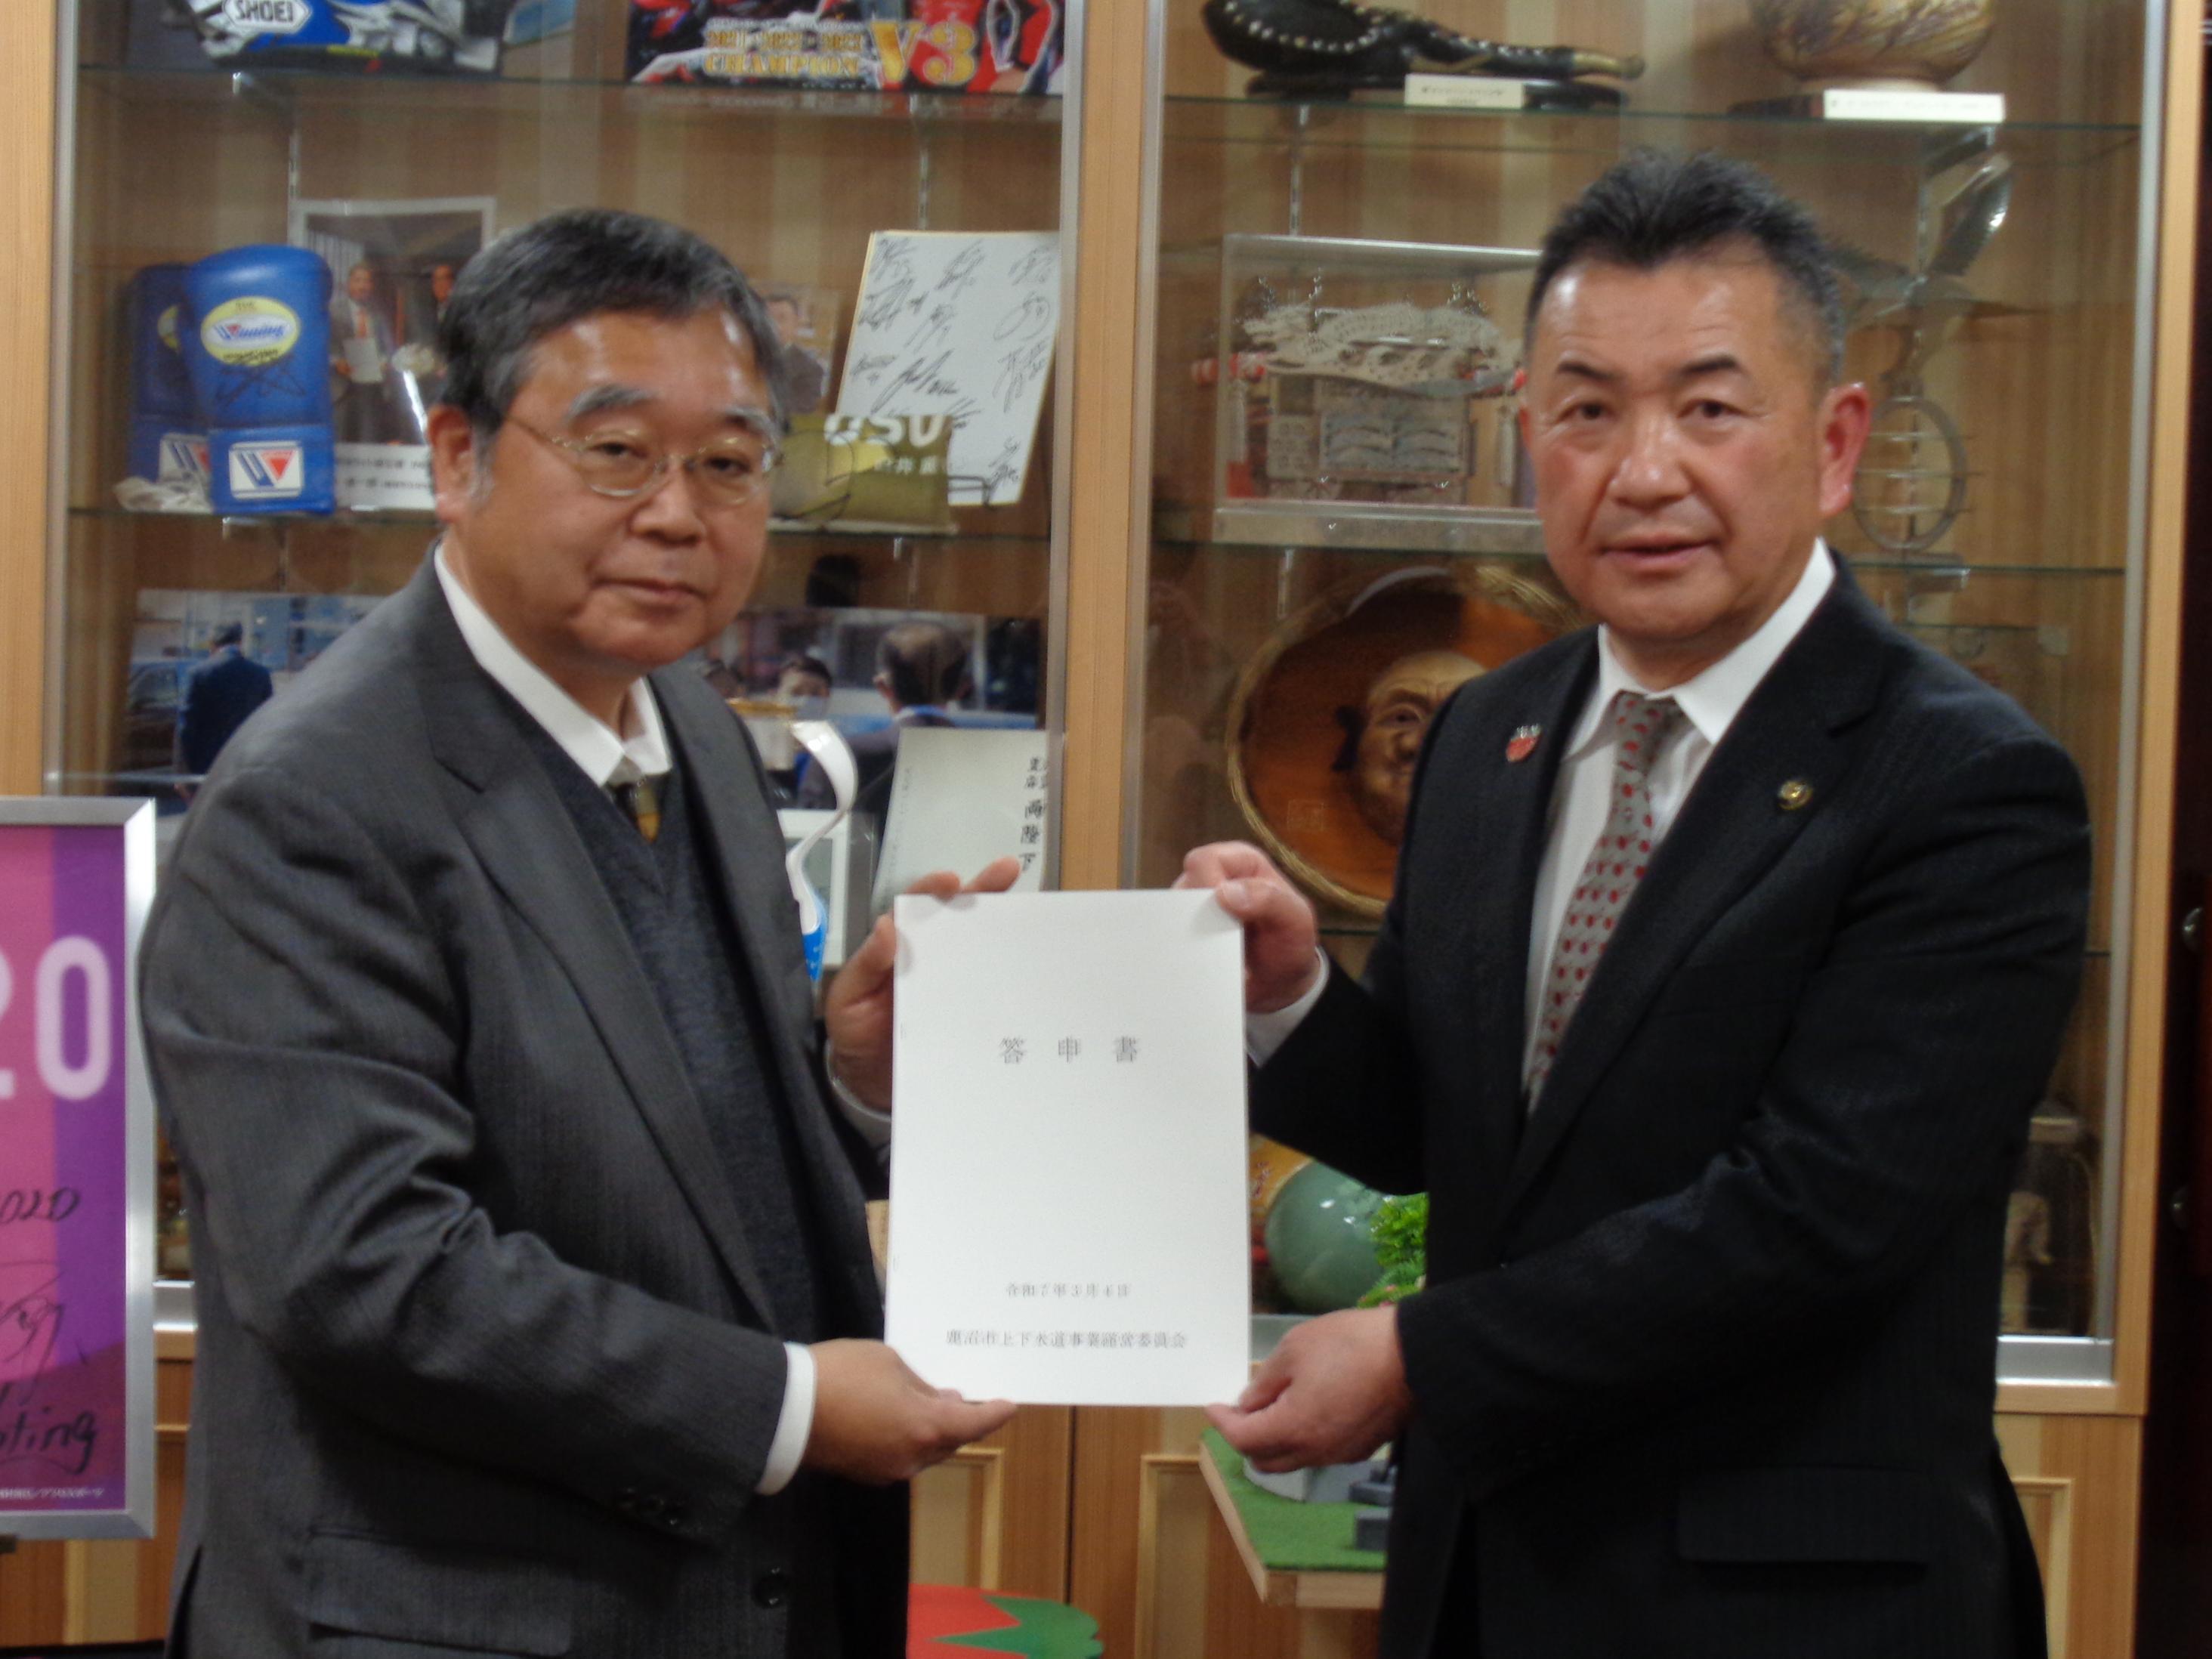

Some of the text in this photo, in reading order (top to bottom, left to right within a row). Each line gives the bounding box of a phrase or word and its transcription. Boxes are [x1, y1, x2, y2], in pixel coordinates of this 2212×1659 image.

[234, 0, 294, 22] SHOEI
[704, 53, 860, 75] CHAMPION
[870, 20, 975, 85] V3
[0, 935, 112, 1101] 0
[999, 1036, 1138, 1064] 答申書
